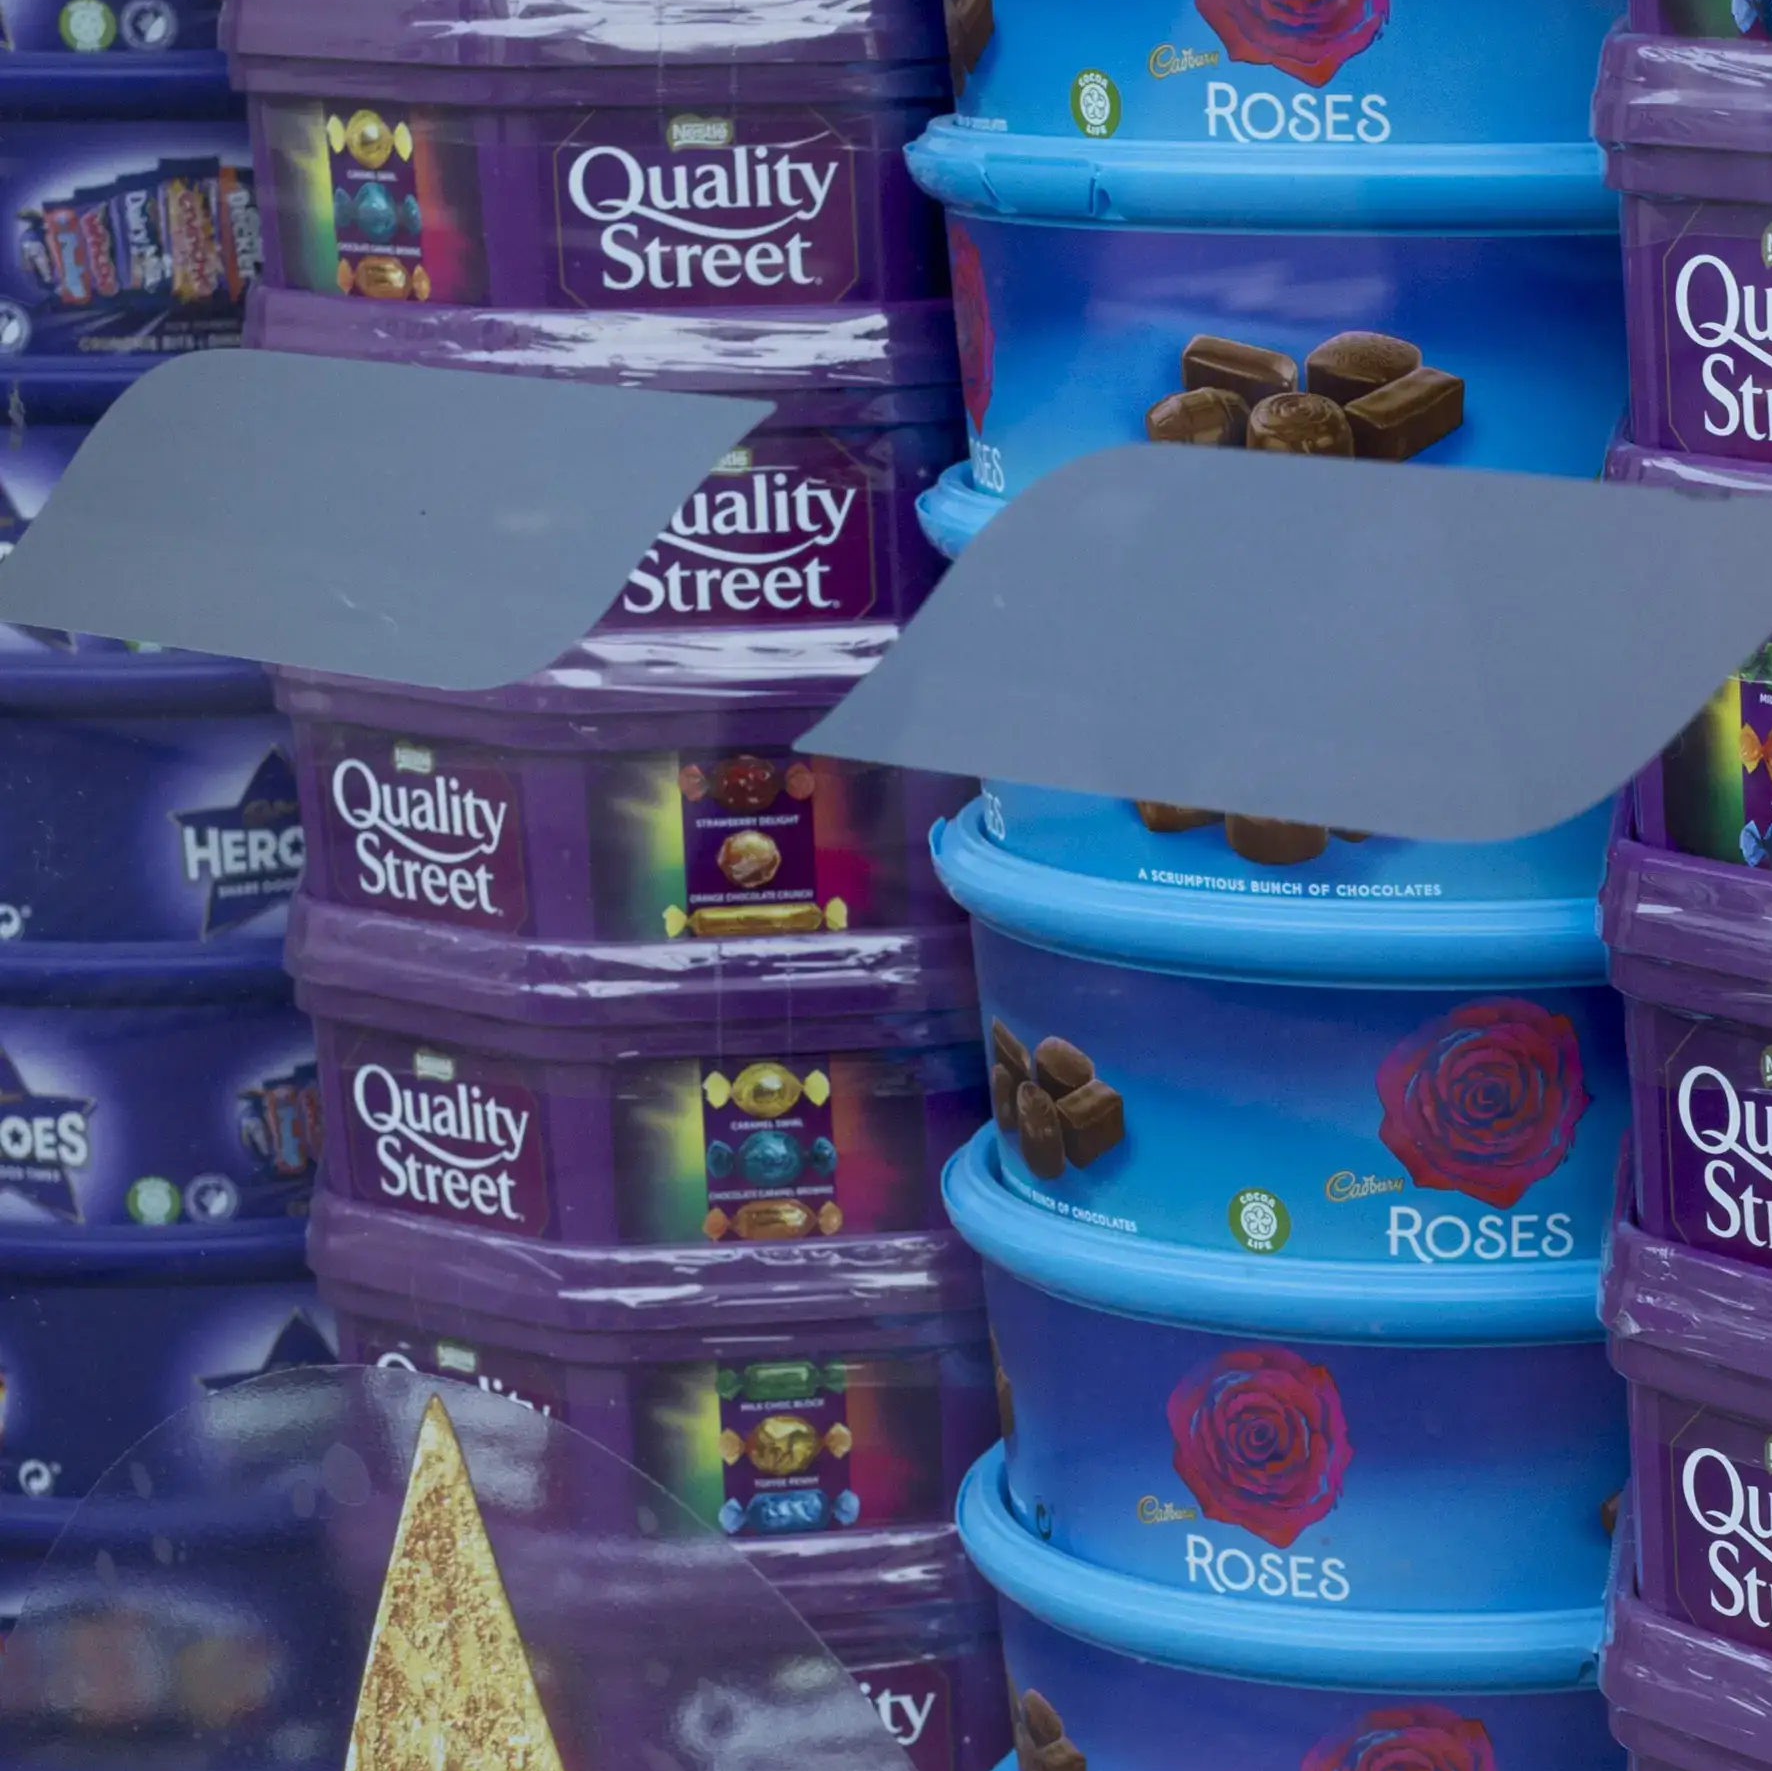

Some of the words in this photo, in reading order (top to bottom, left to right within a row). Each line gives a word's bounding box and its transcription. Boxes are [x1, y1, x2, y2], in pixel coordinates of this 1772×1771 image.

[1149, 43, 1220, 80] Cadbury
[1204, 81, 1392, 144] ROSES
[567, 146, 839, 239] Quality
[601, 225, 813, 291] Street
[658, 472, 857, 564] uality
[623, 551, 832, 614] Street
[333, 758, 507, 864] Quality
[356, 831, 497, 914] Street
[1138, 868, 1148, 880] A
[1151, 869, 1246, 892] SCRUMPTIOUS
[1250, 881, 1302, 895] BUNCH
[1308, 883, 1330, 896] OF
[1336, 883, 1442, 897] CHOCOLATES
[0, 1112, 89, 1166] OES
[354, 1064, 530, 1169] Quality
[377, 1135, 520, 1221] Street
[1325, 1171, 1404, 1204] Cadbury
[1386, 1205, 1574, 1264] ROSES
[1137, 1493, 1197, 1525] Cadbury
[1185, 1532, 1350, 1602] ROSES
